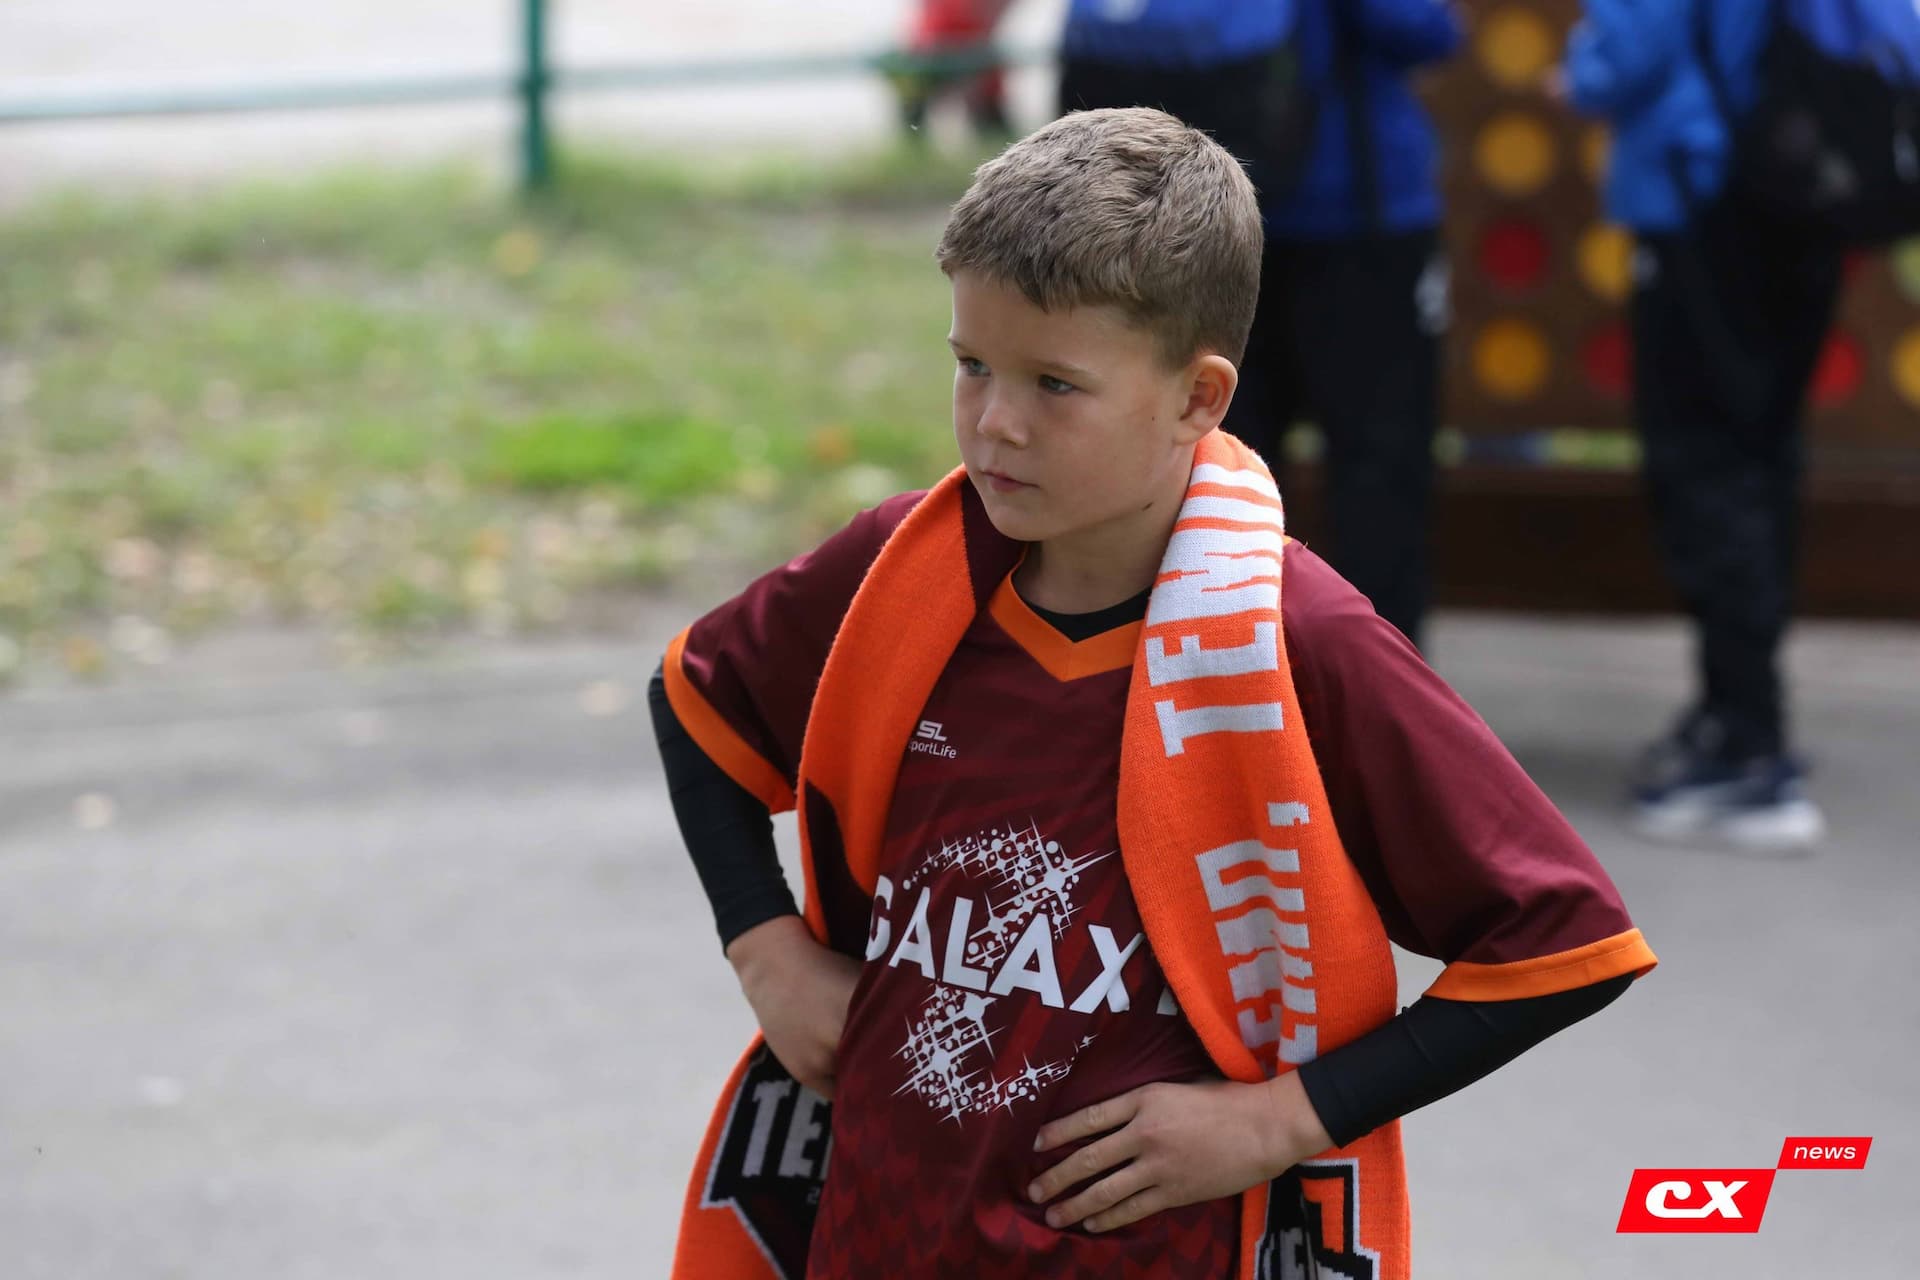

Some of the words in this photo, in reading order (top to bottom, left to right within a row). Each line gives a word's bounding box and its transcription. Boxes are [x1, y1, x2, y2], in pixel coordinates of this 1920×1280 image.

[909, 740, 957, 759] portLife
[916, 719, 947, 742] SL
[865, 874, 1178, 1015] GALAX
[1195, 801, 1317, 1078] ЕМП,
